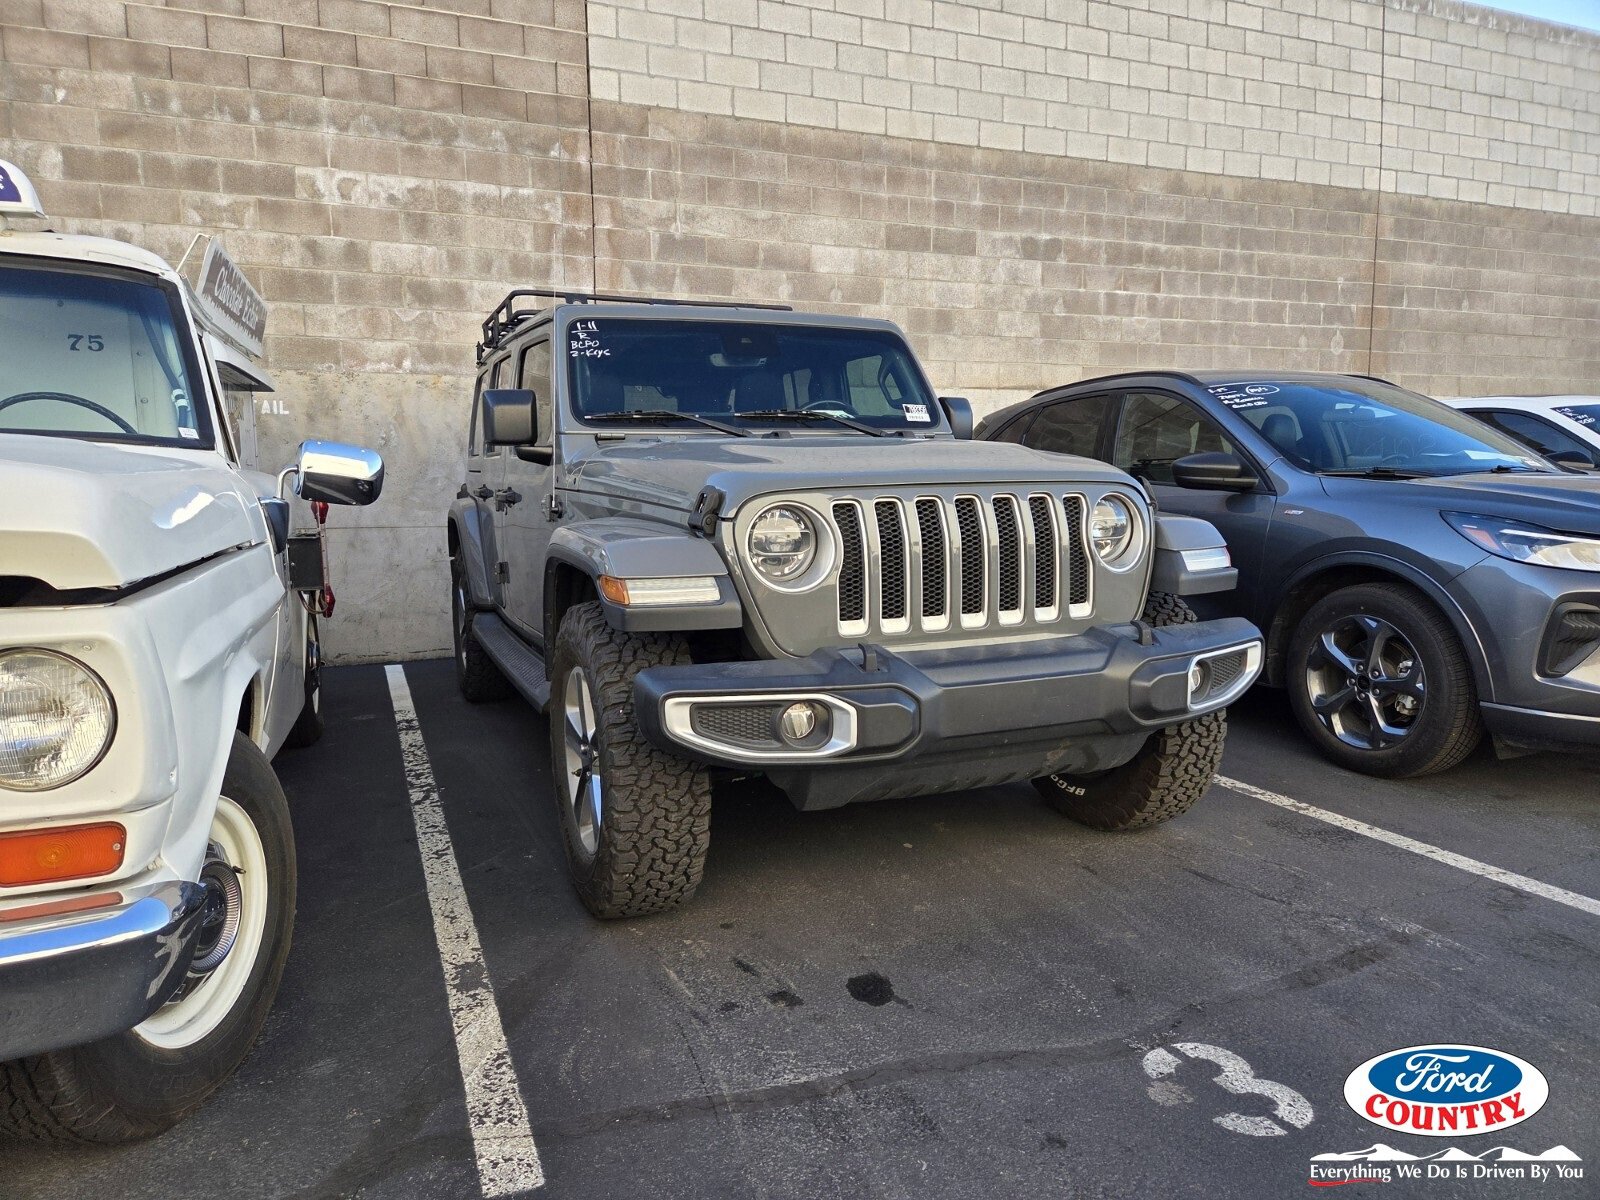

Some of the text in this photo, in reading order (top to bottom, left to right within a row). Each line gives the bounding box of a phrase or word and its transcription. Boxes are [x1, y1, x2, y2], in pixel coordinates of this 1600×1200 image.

[67, 334, 105, 351] 75
[253, 400, 290, 415] AIL
[1142, 1042, 1315, 1137] 3
